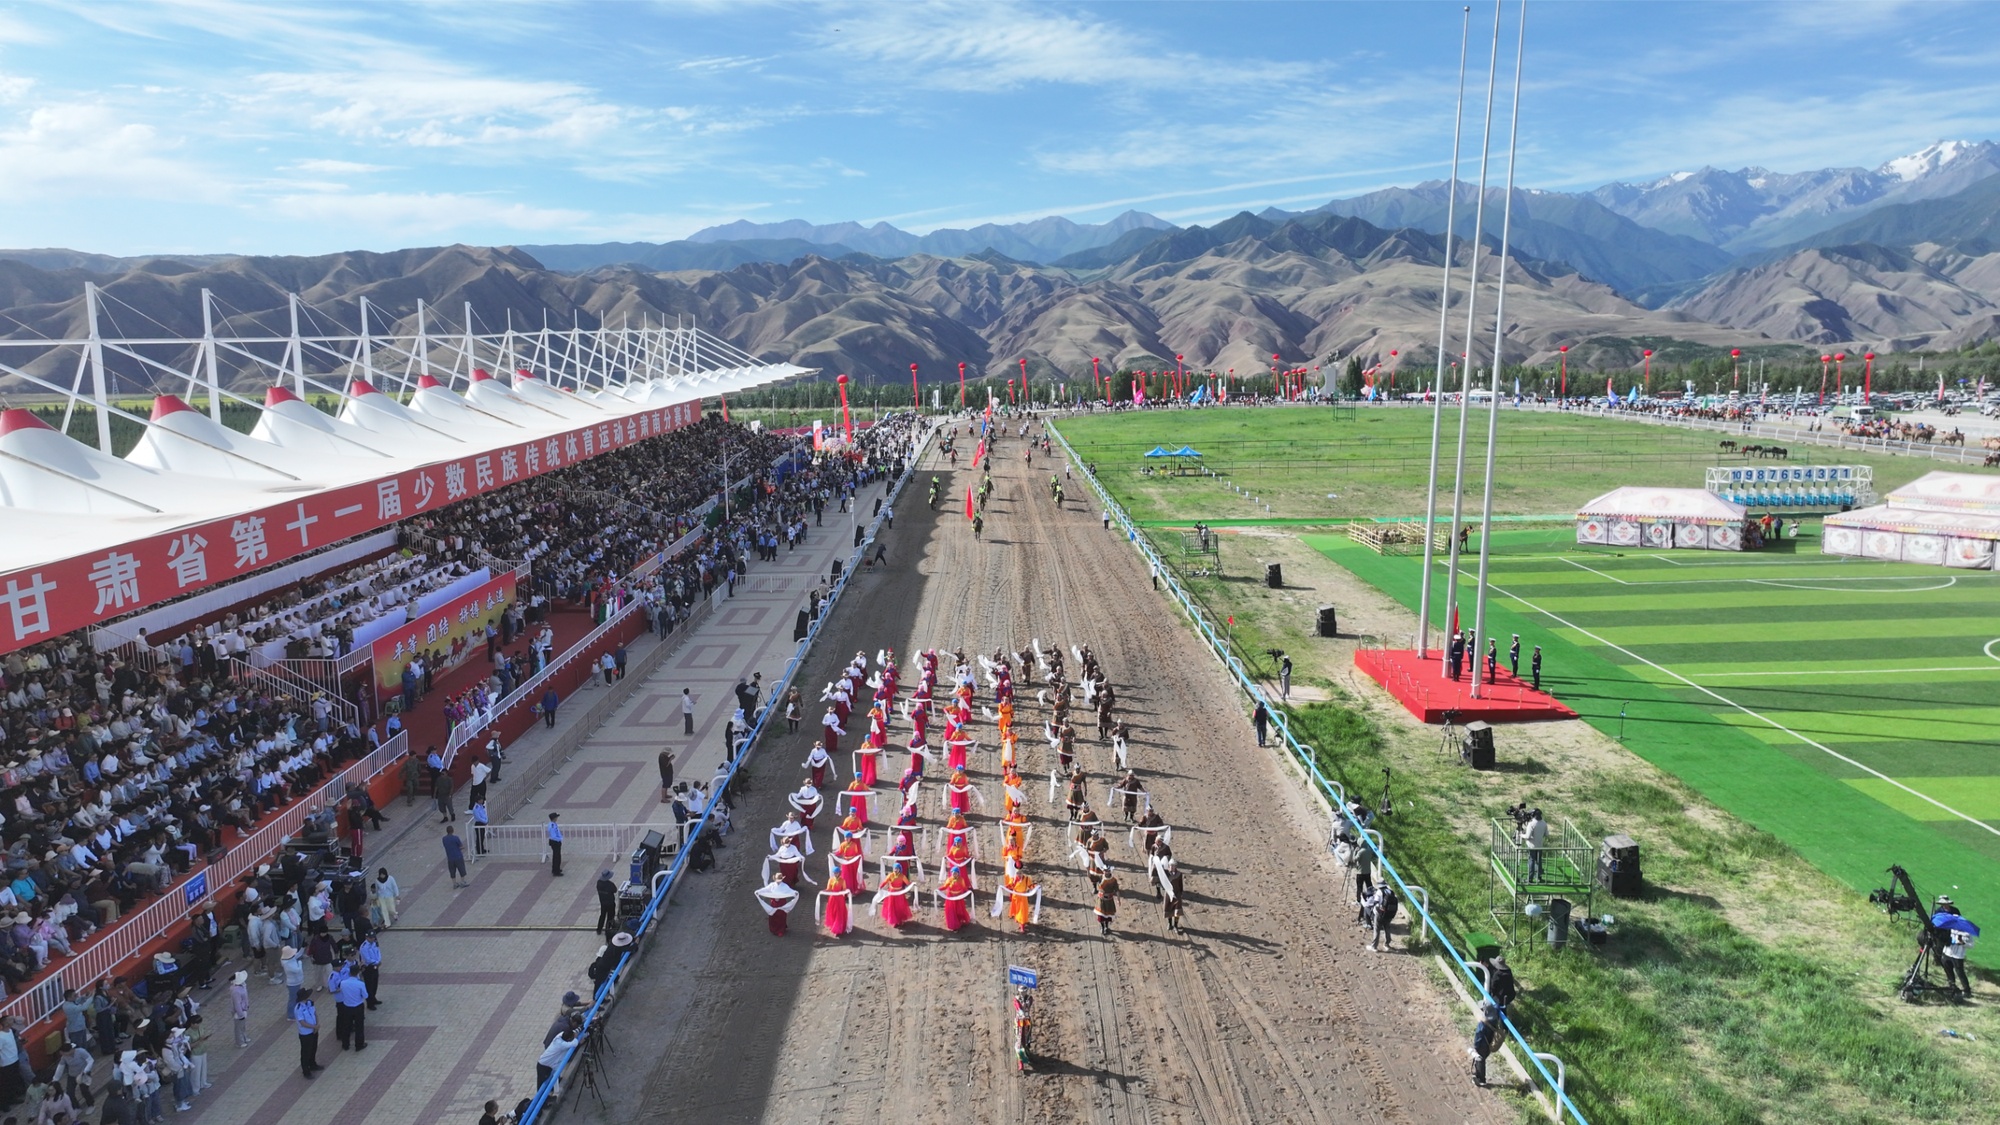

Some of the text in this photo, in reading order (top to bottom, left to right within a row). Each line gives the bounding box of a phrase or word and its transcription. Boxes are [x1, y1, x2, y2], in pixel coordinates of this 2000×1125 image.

[1732, 468, 1848, 480] 10 9 8 7 6 5 4 3 2 1
[0, 403, 692, 642] 甘肃省第十一届少数民族传统体育运动会肃南分赛场
[394, 586, 506, 663] 平等 团结 拼搏 奋进
